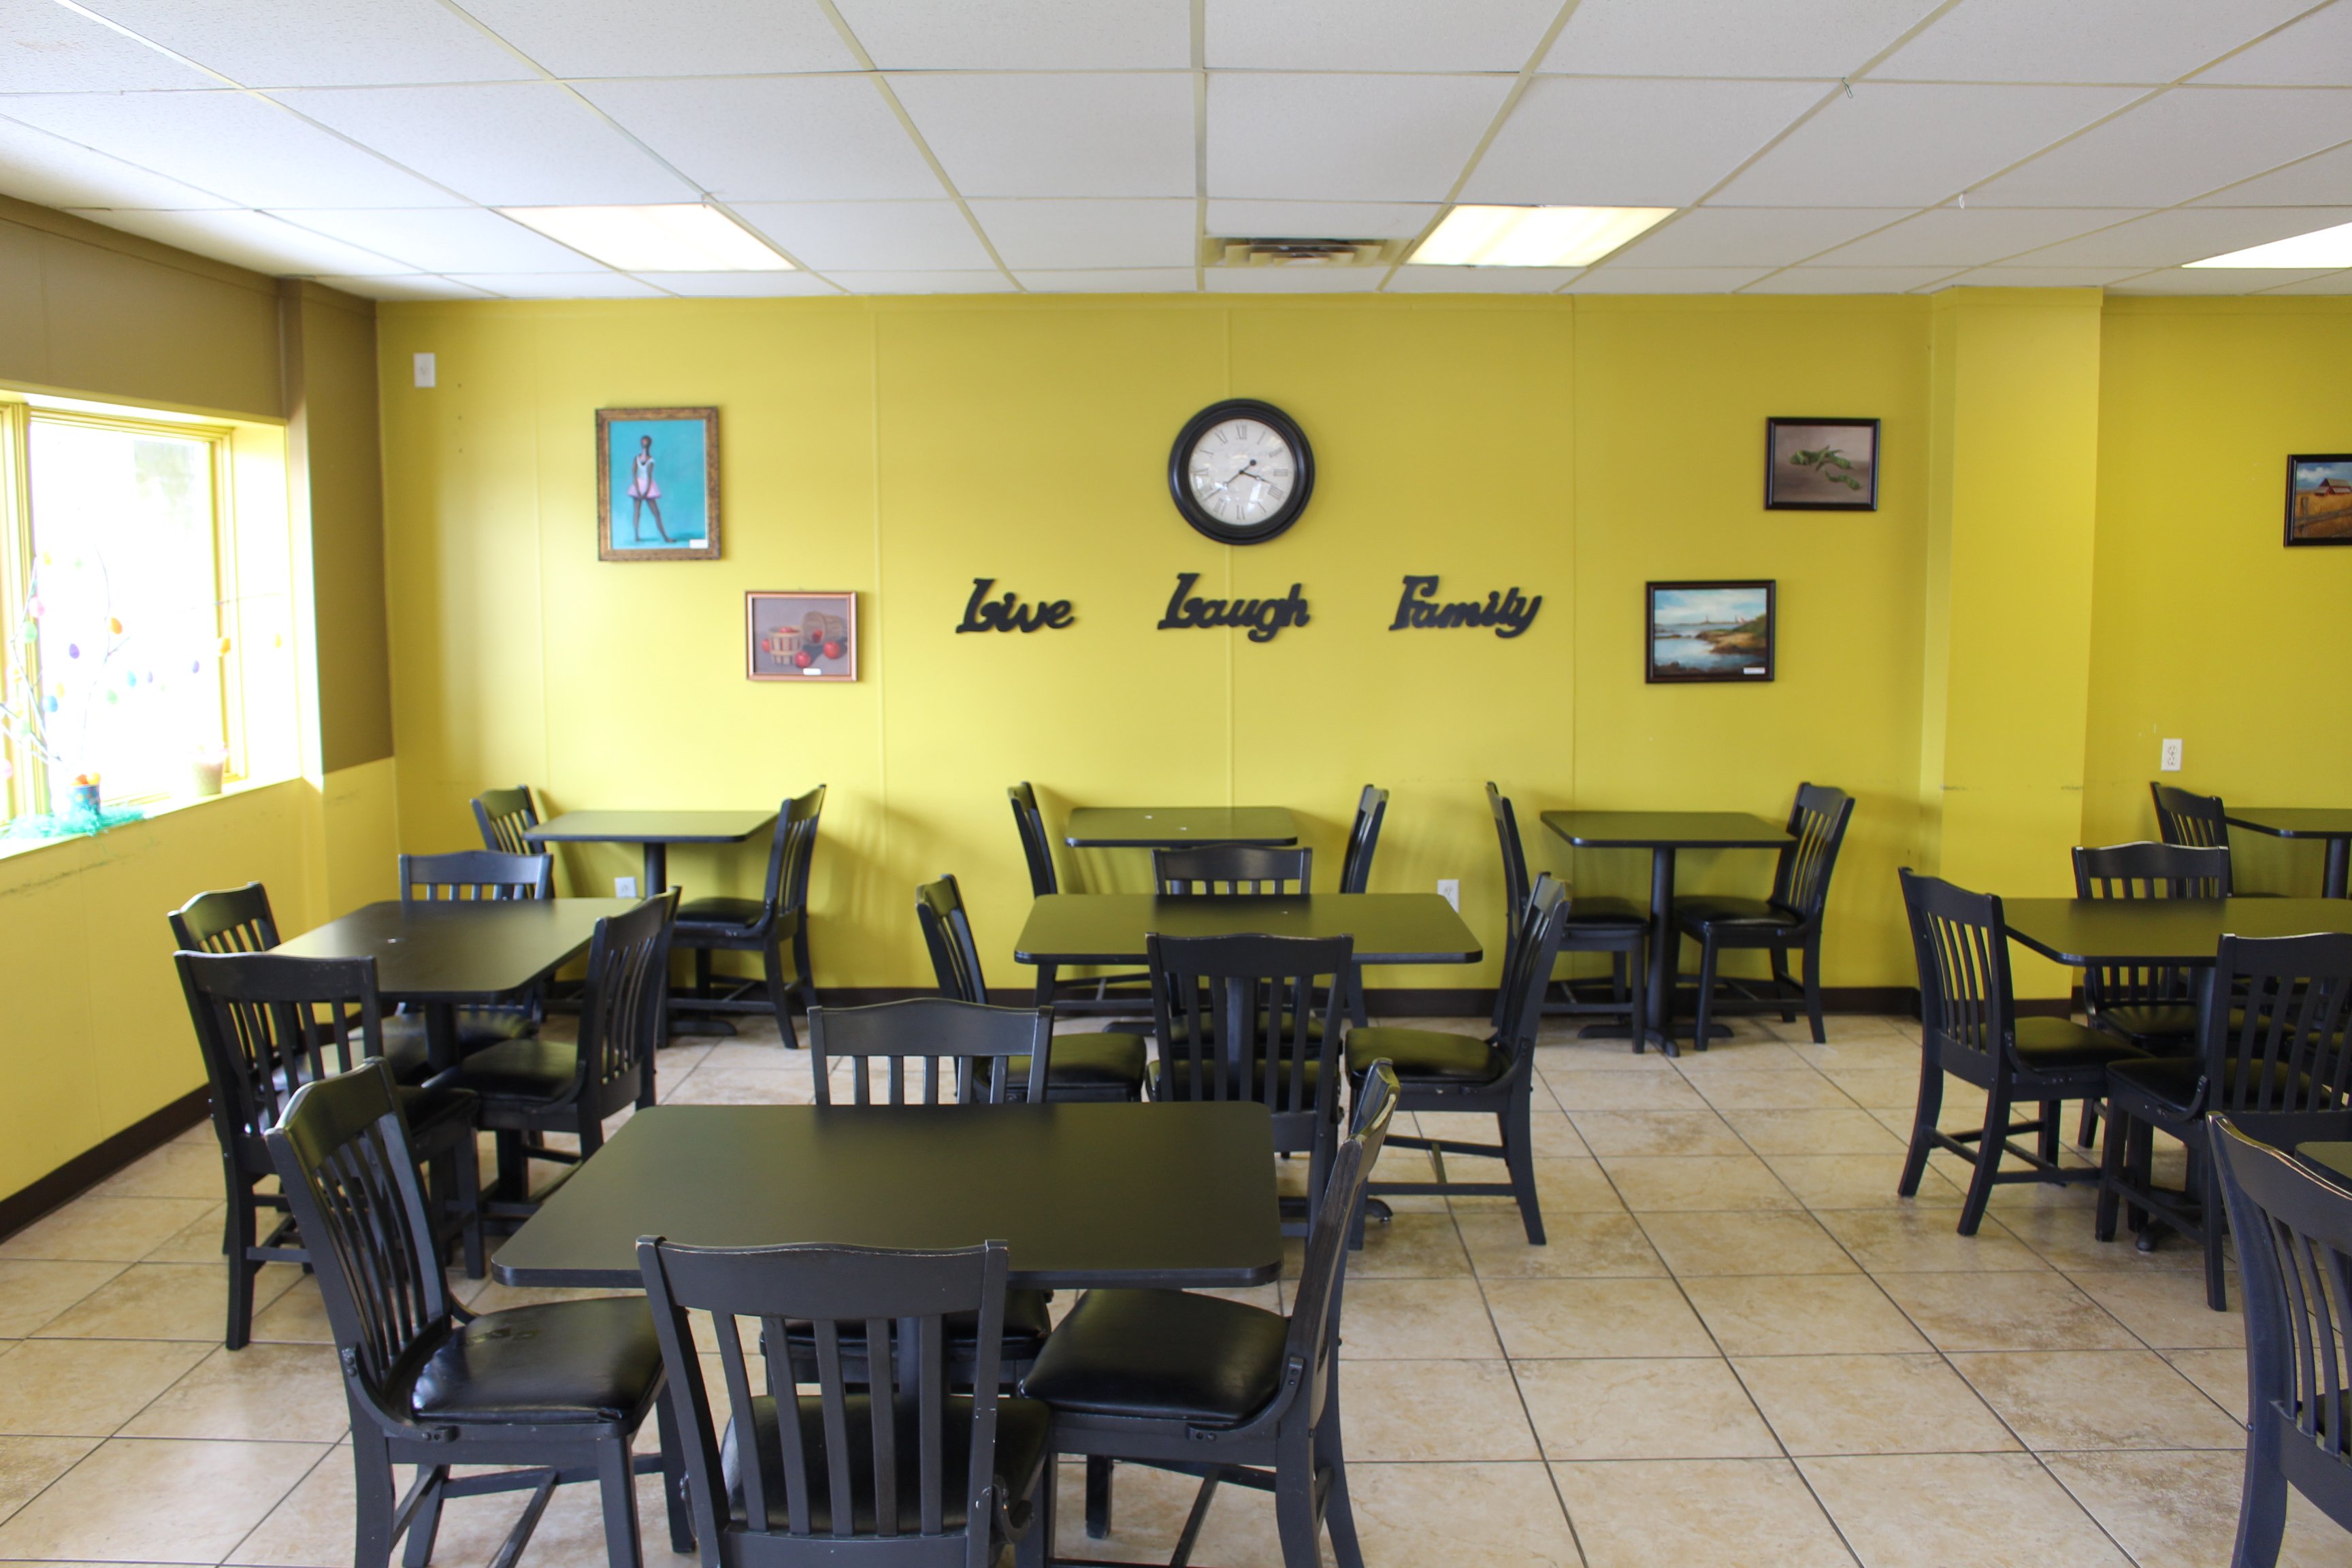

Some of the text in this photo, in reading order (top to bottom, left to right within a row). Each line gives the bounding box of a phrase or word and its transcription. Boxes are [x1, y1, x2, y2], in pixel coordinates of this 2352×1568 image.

[956, 573, 1542, 643] Live Laugh Family
